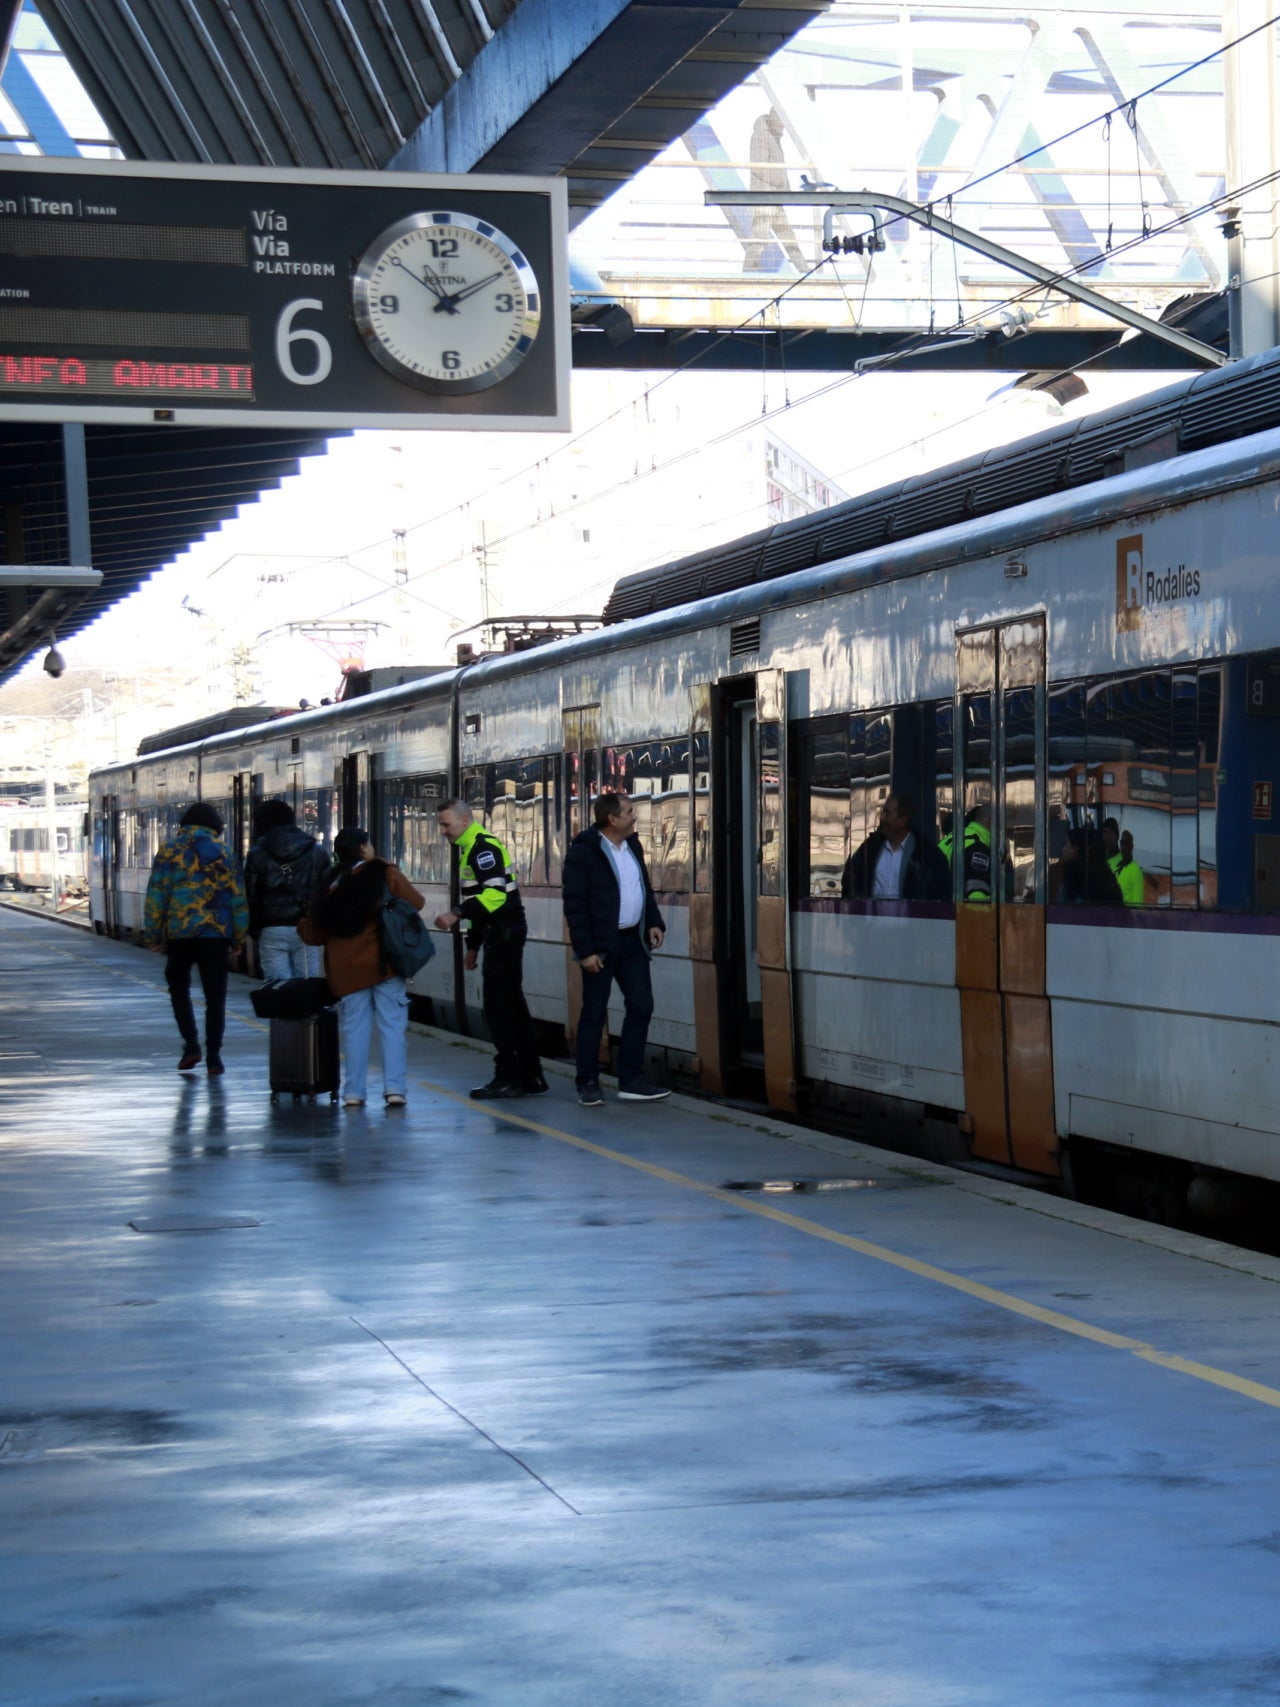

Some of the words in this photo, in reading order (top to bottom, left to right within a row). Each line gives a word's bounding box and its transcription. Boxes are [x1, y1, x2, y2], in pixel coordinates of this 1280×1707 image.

[30, 198, 73, 216] Tren
[86, 206, 117, 216] TRAIN
[253, 209, 288, 232] Vía
[253, 235, 290, 257] Via
[427, 238, 460, 258] 12
[255, 261, 336, 276] PLATFORM
[424, 276, 468, 286] FESTINA
[379, 295, 400, 315] 9
[495, 294, 514, 313] 3
[276, 297, 333, 386] 6
[0, 356, 87, 385] NFA
[442, 351, 461, 370] 6
[1146, 564, 1201, 606] Rodalies
